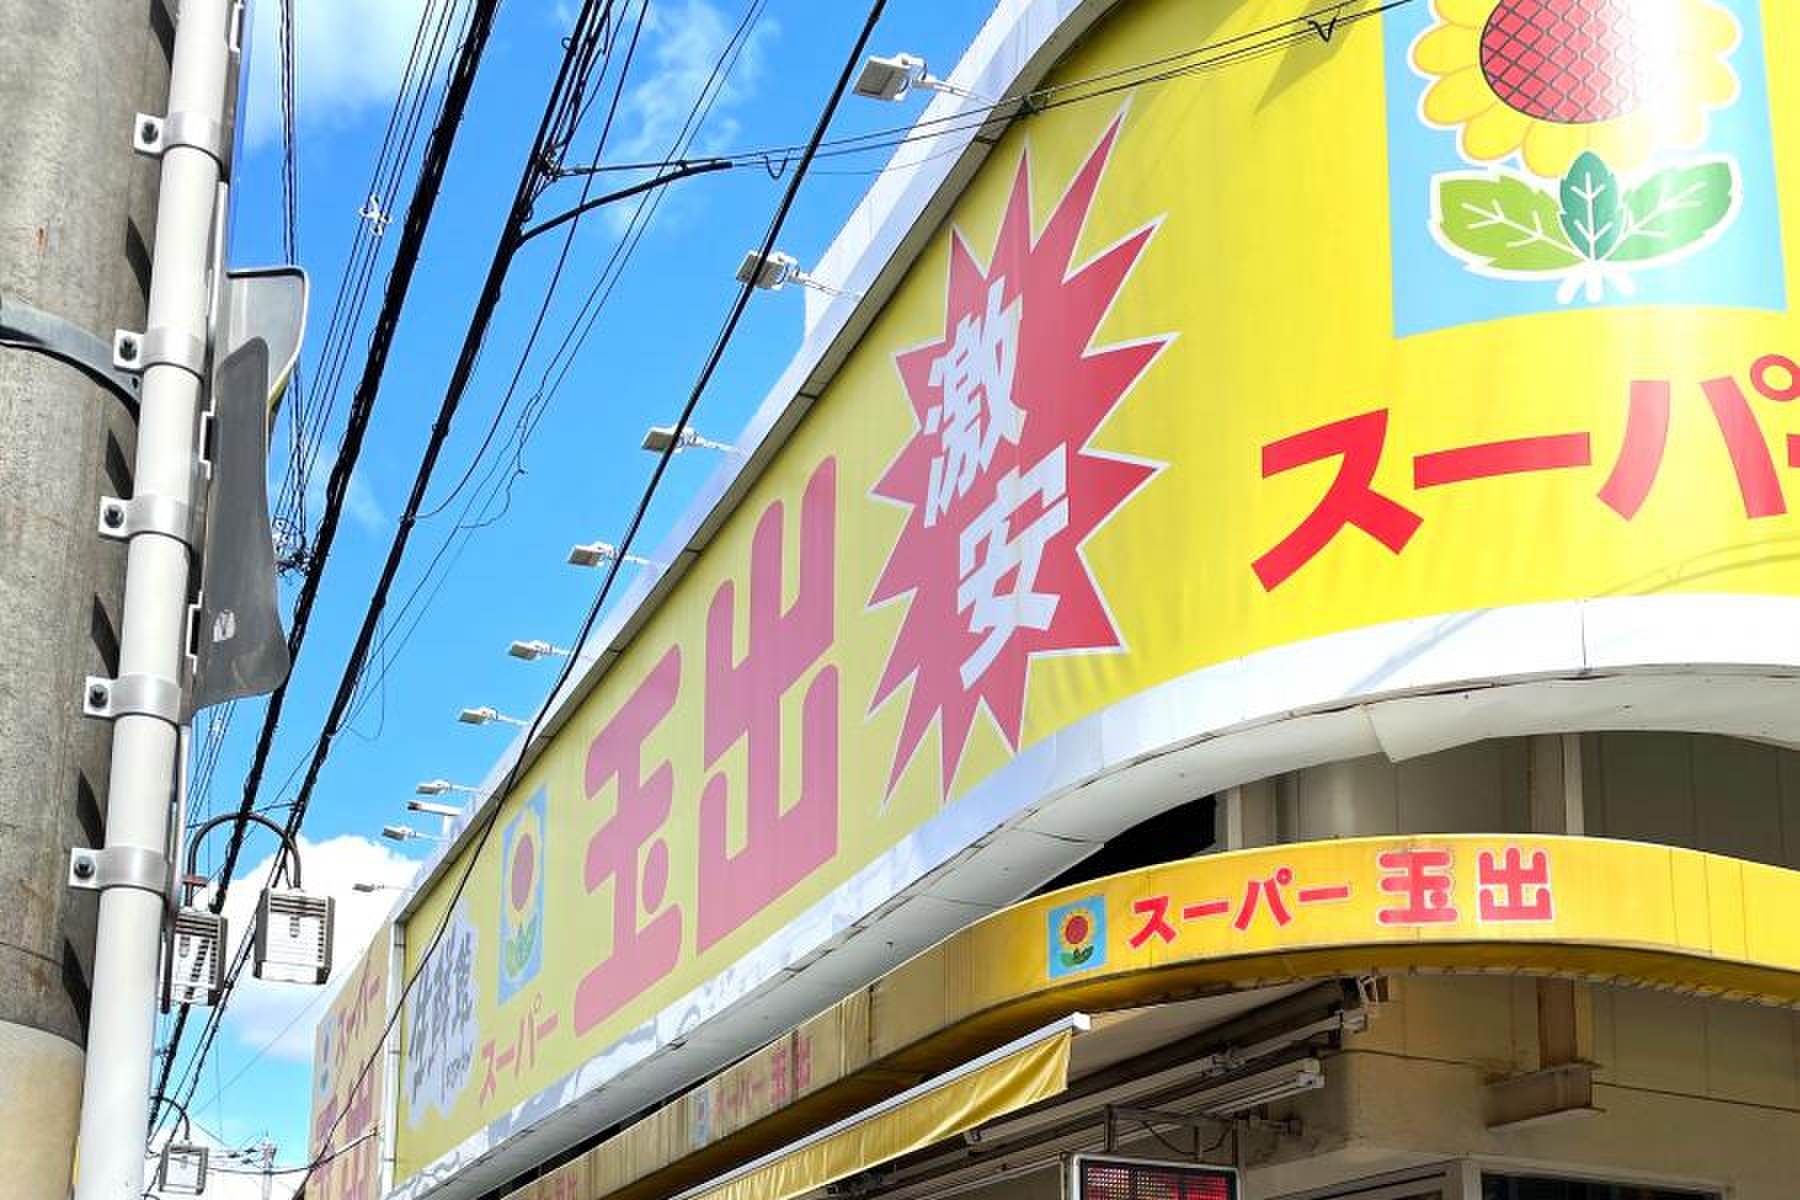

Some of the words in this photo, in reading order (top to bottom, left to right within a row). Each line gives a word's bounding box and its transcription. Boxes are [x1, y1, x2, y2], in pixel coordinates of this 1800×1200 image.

[923, 277, 1070, 690] 激安
[1251, 354, 1800, 593] スーパ
[574, 455, 841, 1039] 玉出
[479, 986, 559, 1107] スーパー
